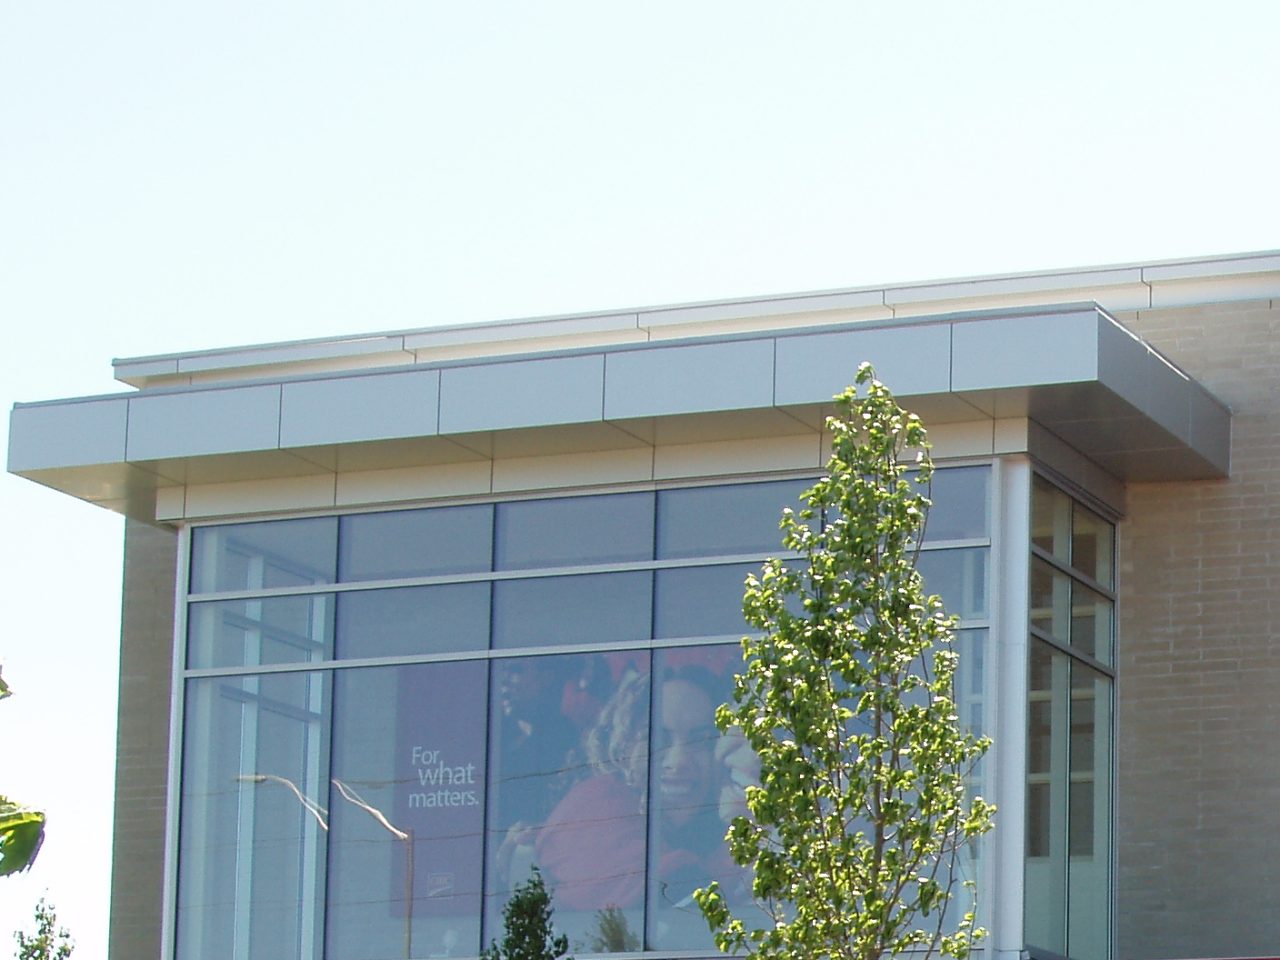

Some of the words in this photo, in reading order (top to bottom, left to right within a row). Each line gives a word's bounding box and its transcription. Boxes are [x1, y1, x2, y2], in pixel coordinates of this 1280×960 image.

[411, 746, 440, 765] For
[418, 760, 476, 786] what
[408, 789, 480, 808] matters.
